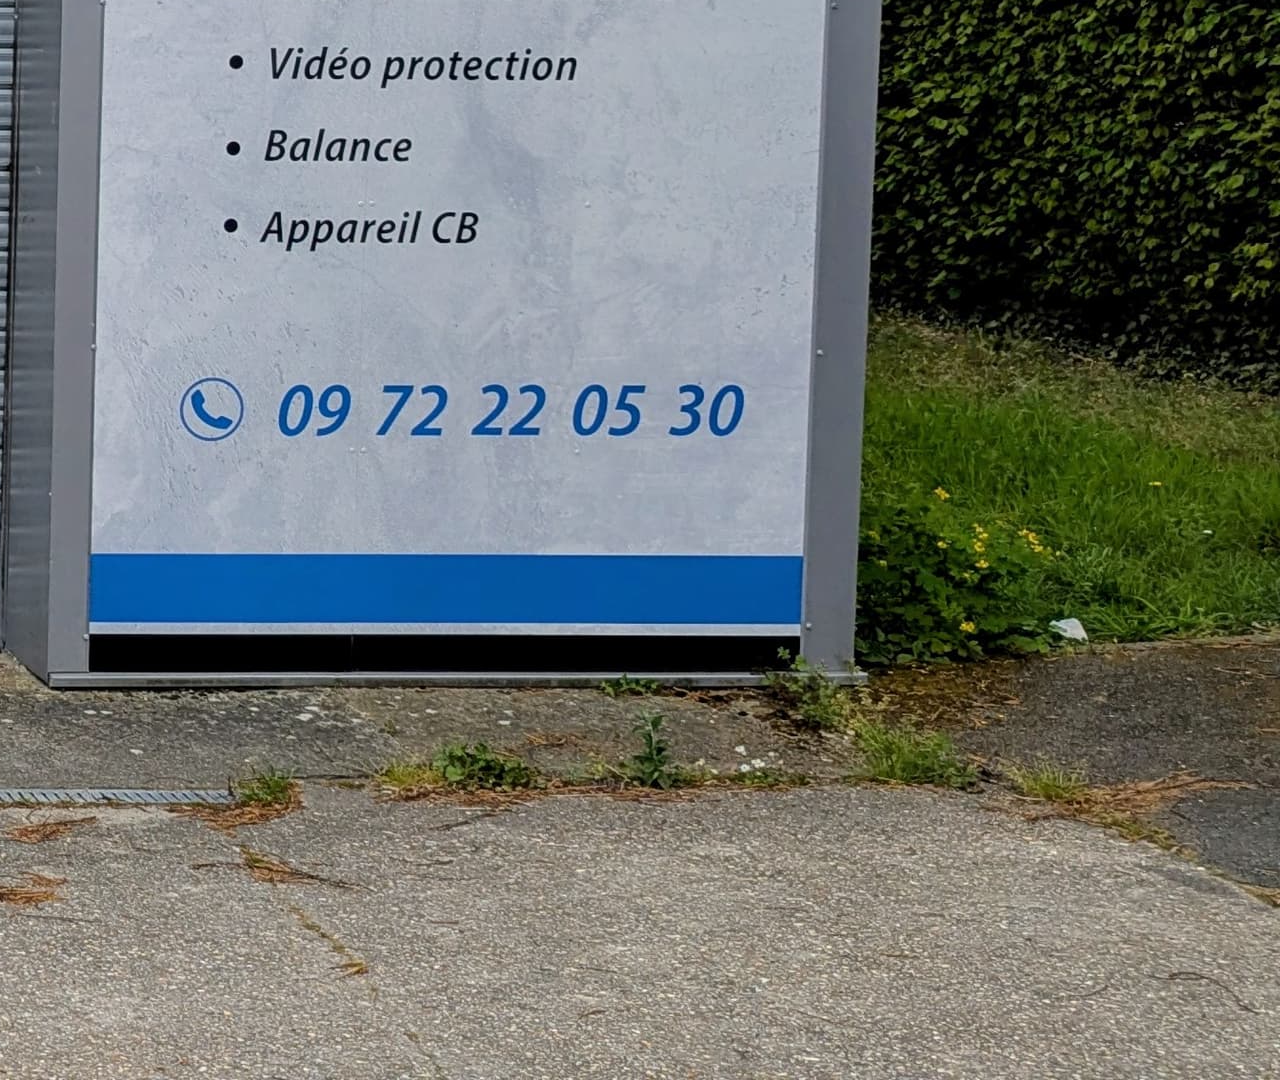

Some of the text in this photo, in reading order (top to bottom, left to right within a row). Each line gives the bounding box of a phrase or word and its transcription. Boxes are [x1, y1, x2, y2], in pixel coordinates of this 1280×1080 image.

[270, 46, 578, 89] Vidéo protection
[264, 129, 412, 162] Balance
[260, 210, 479, 252] Appareil CB
[278, 384, 745, 437] 09 72 22 05 30
